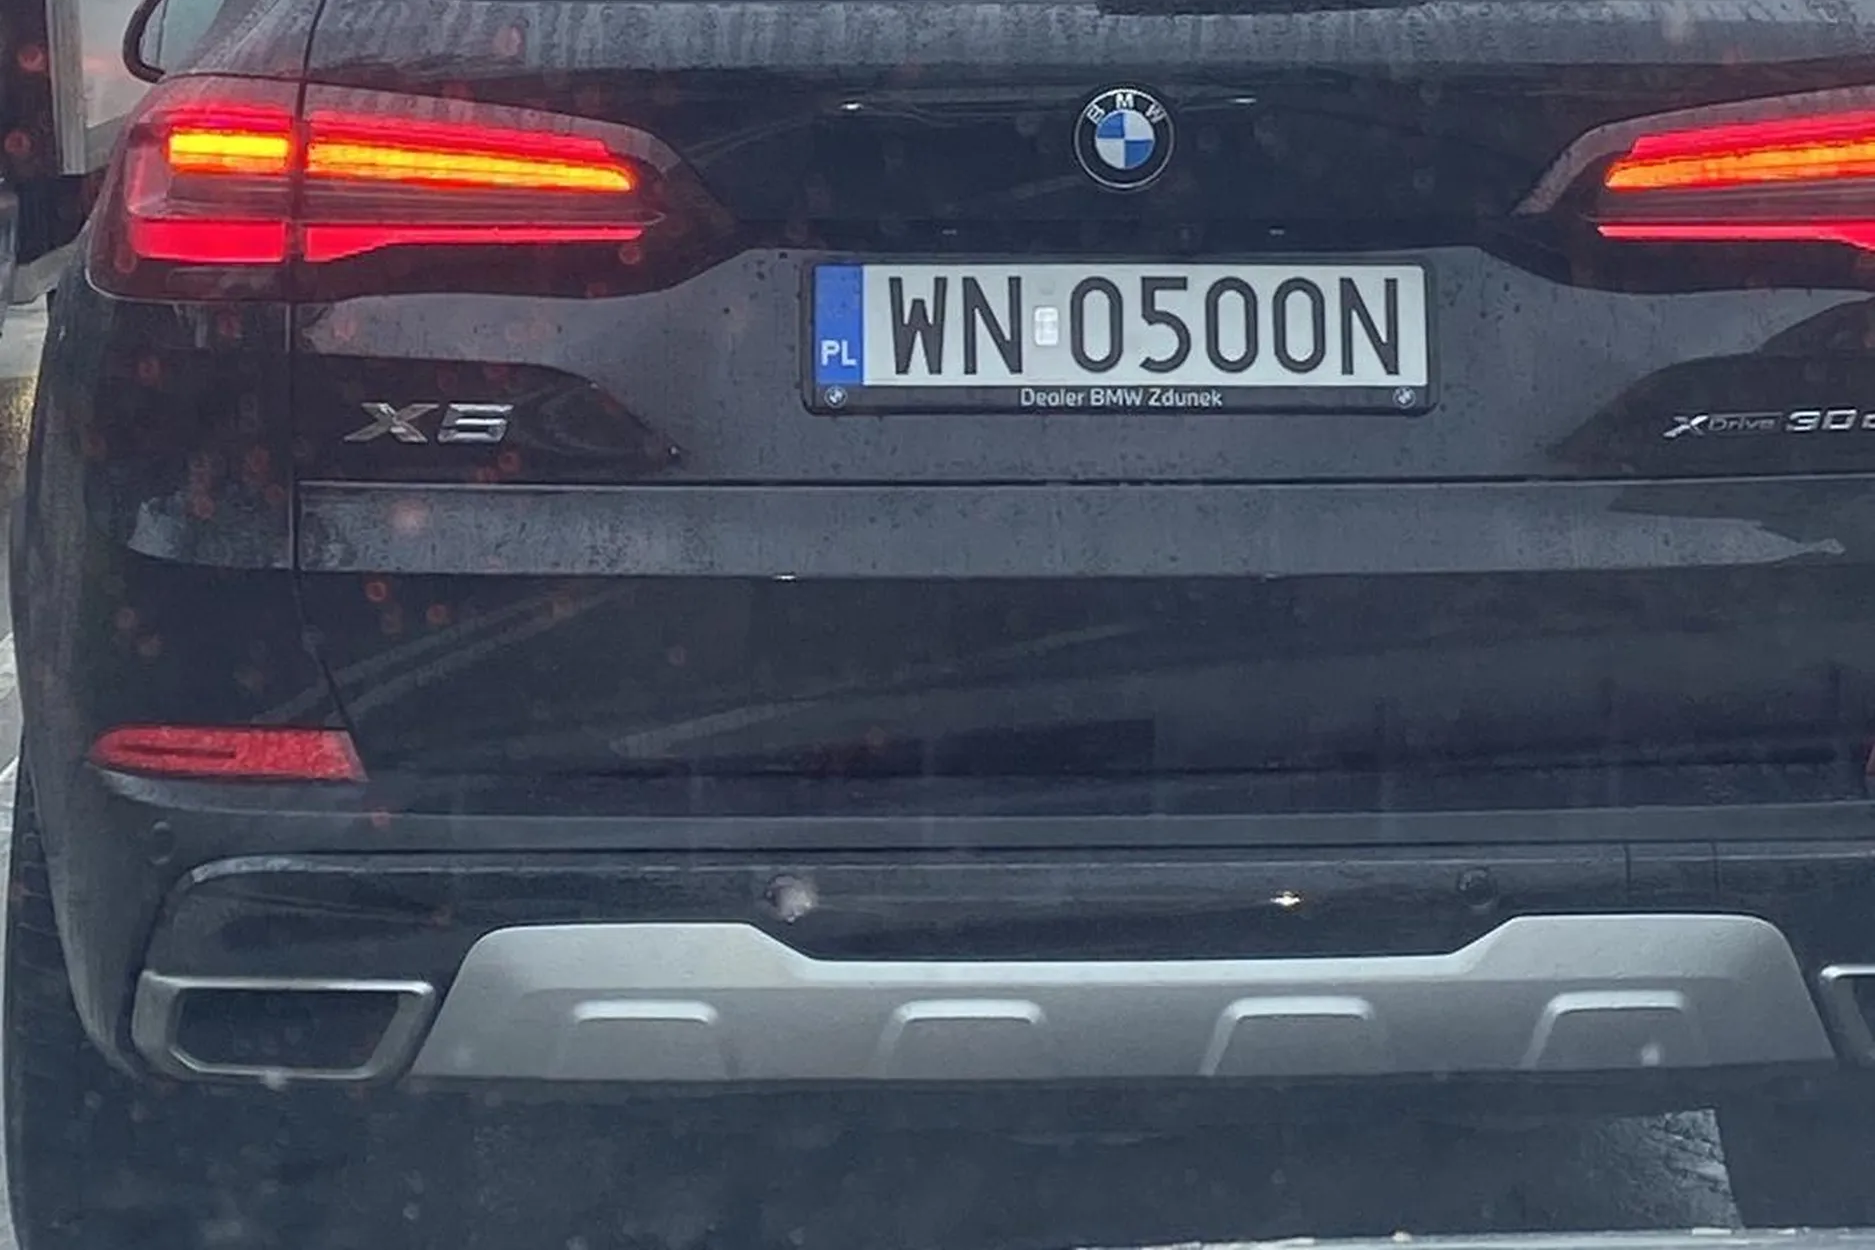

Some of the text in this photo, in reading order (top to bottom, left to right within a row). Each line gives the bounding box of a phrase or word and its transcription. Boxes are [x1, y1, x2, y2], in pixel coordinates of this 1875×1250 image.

[1086, 92, 1167, 125] BMW
[888, 275, 1401, 375] WN 0500N
[820, 340, 857, 365] PL
[1020, 388, 1223, 407] Dealer BMW Zdunek
[344, 402, 515, 443] X5
